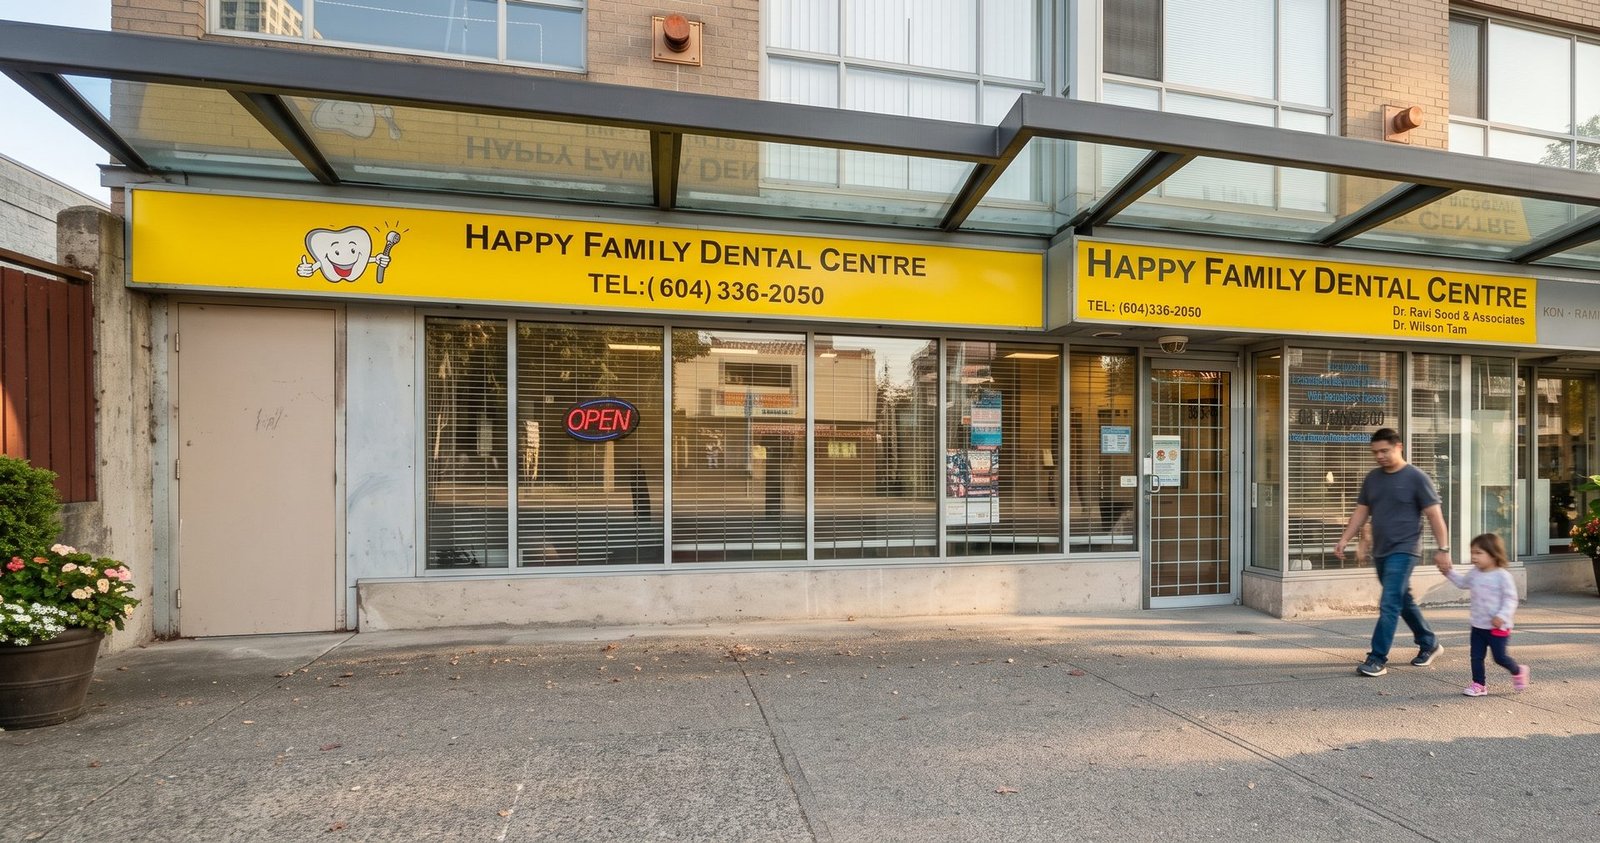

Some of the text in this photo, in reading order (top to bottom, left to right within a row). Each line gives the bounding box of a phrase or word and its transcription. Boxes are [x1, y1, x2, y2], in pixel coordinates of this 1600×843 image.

[466, 223, 927, 277] HAPPY FAMILY DENTAL CENTRE
[1087, 247, 1527, 309] HAPPY FAMILY DENTAL CENTRE
[717, 281, 824, 305] 336-2050
[1087, 299, 1202, 318] TEL: (604)336-2050
[1393, 305, 1525, 326] Dr. Ravi Sood & Associates
[1543, 306, 1564, 318] KON
[1393, 319, 1467, 335] Dr. Wilson Tam
[567, 408, 632, 431] OPEN
